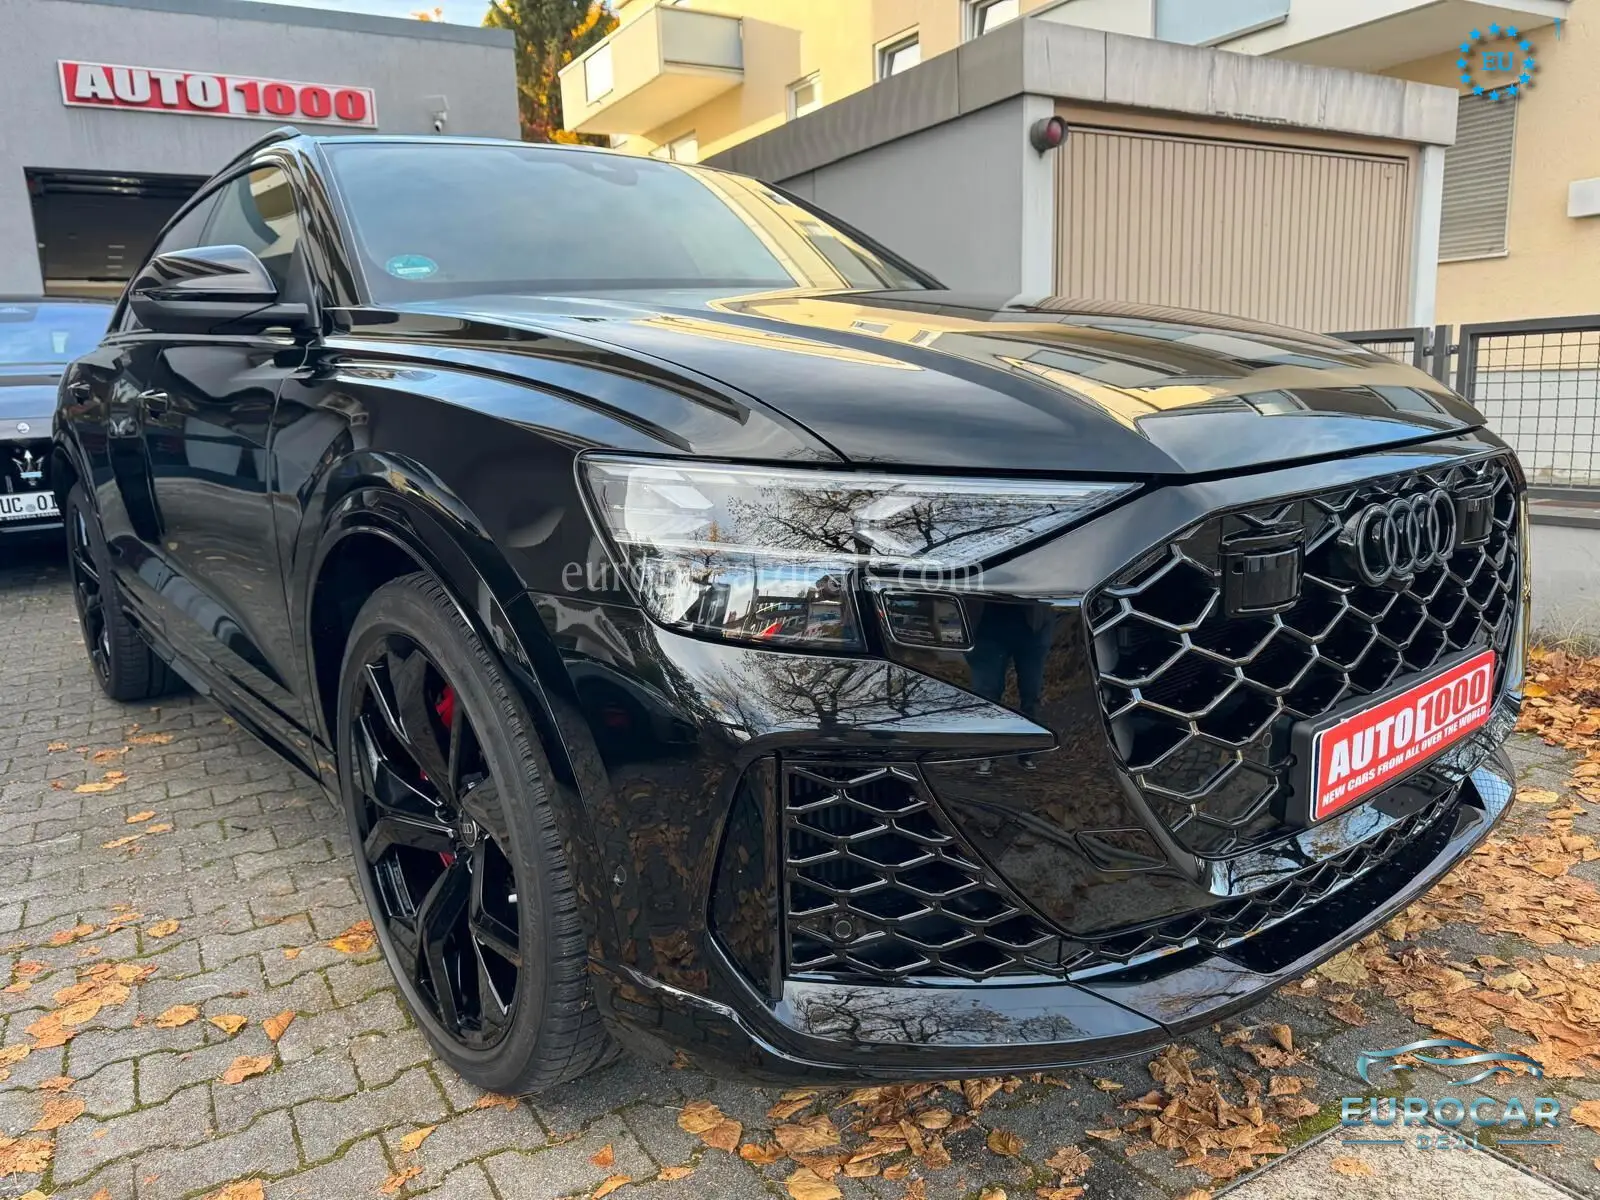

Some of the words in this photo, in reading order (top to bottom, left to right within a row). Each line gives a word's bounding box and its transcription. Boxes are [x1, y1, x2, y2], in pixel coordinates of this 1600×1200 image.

[73, 63, 224, 109] AUTO
[234, 81, 367, 121] 1000
[1321, 784, 1345, 808] NEW
[1347, 769, 1376, 792] CARS
[1377, 755, 1404, 777] FROM
[1405, 745, 1420, 762] ALL
[1421, 733, 1443, 752] OVER
[1444, 724, 1458, 740] THE
[1459, 706, 1486, 727] WORLD
[1327, 706, 1415, 786] AUTO
[1420, 669, 1487, 732] 1000
